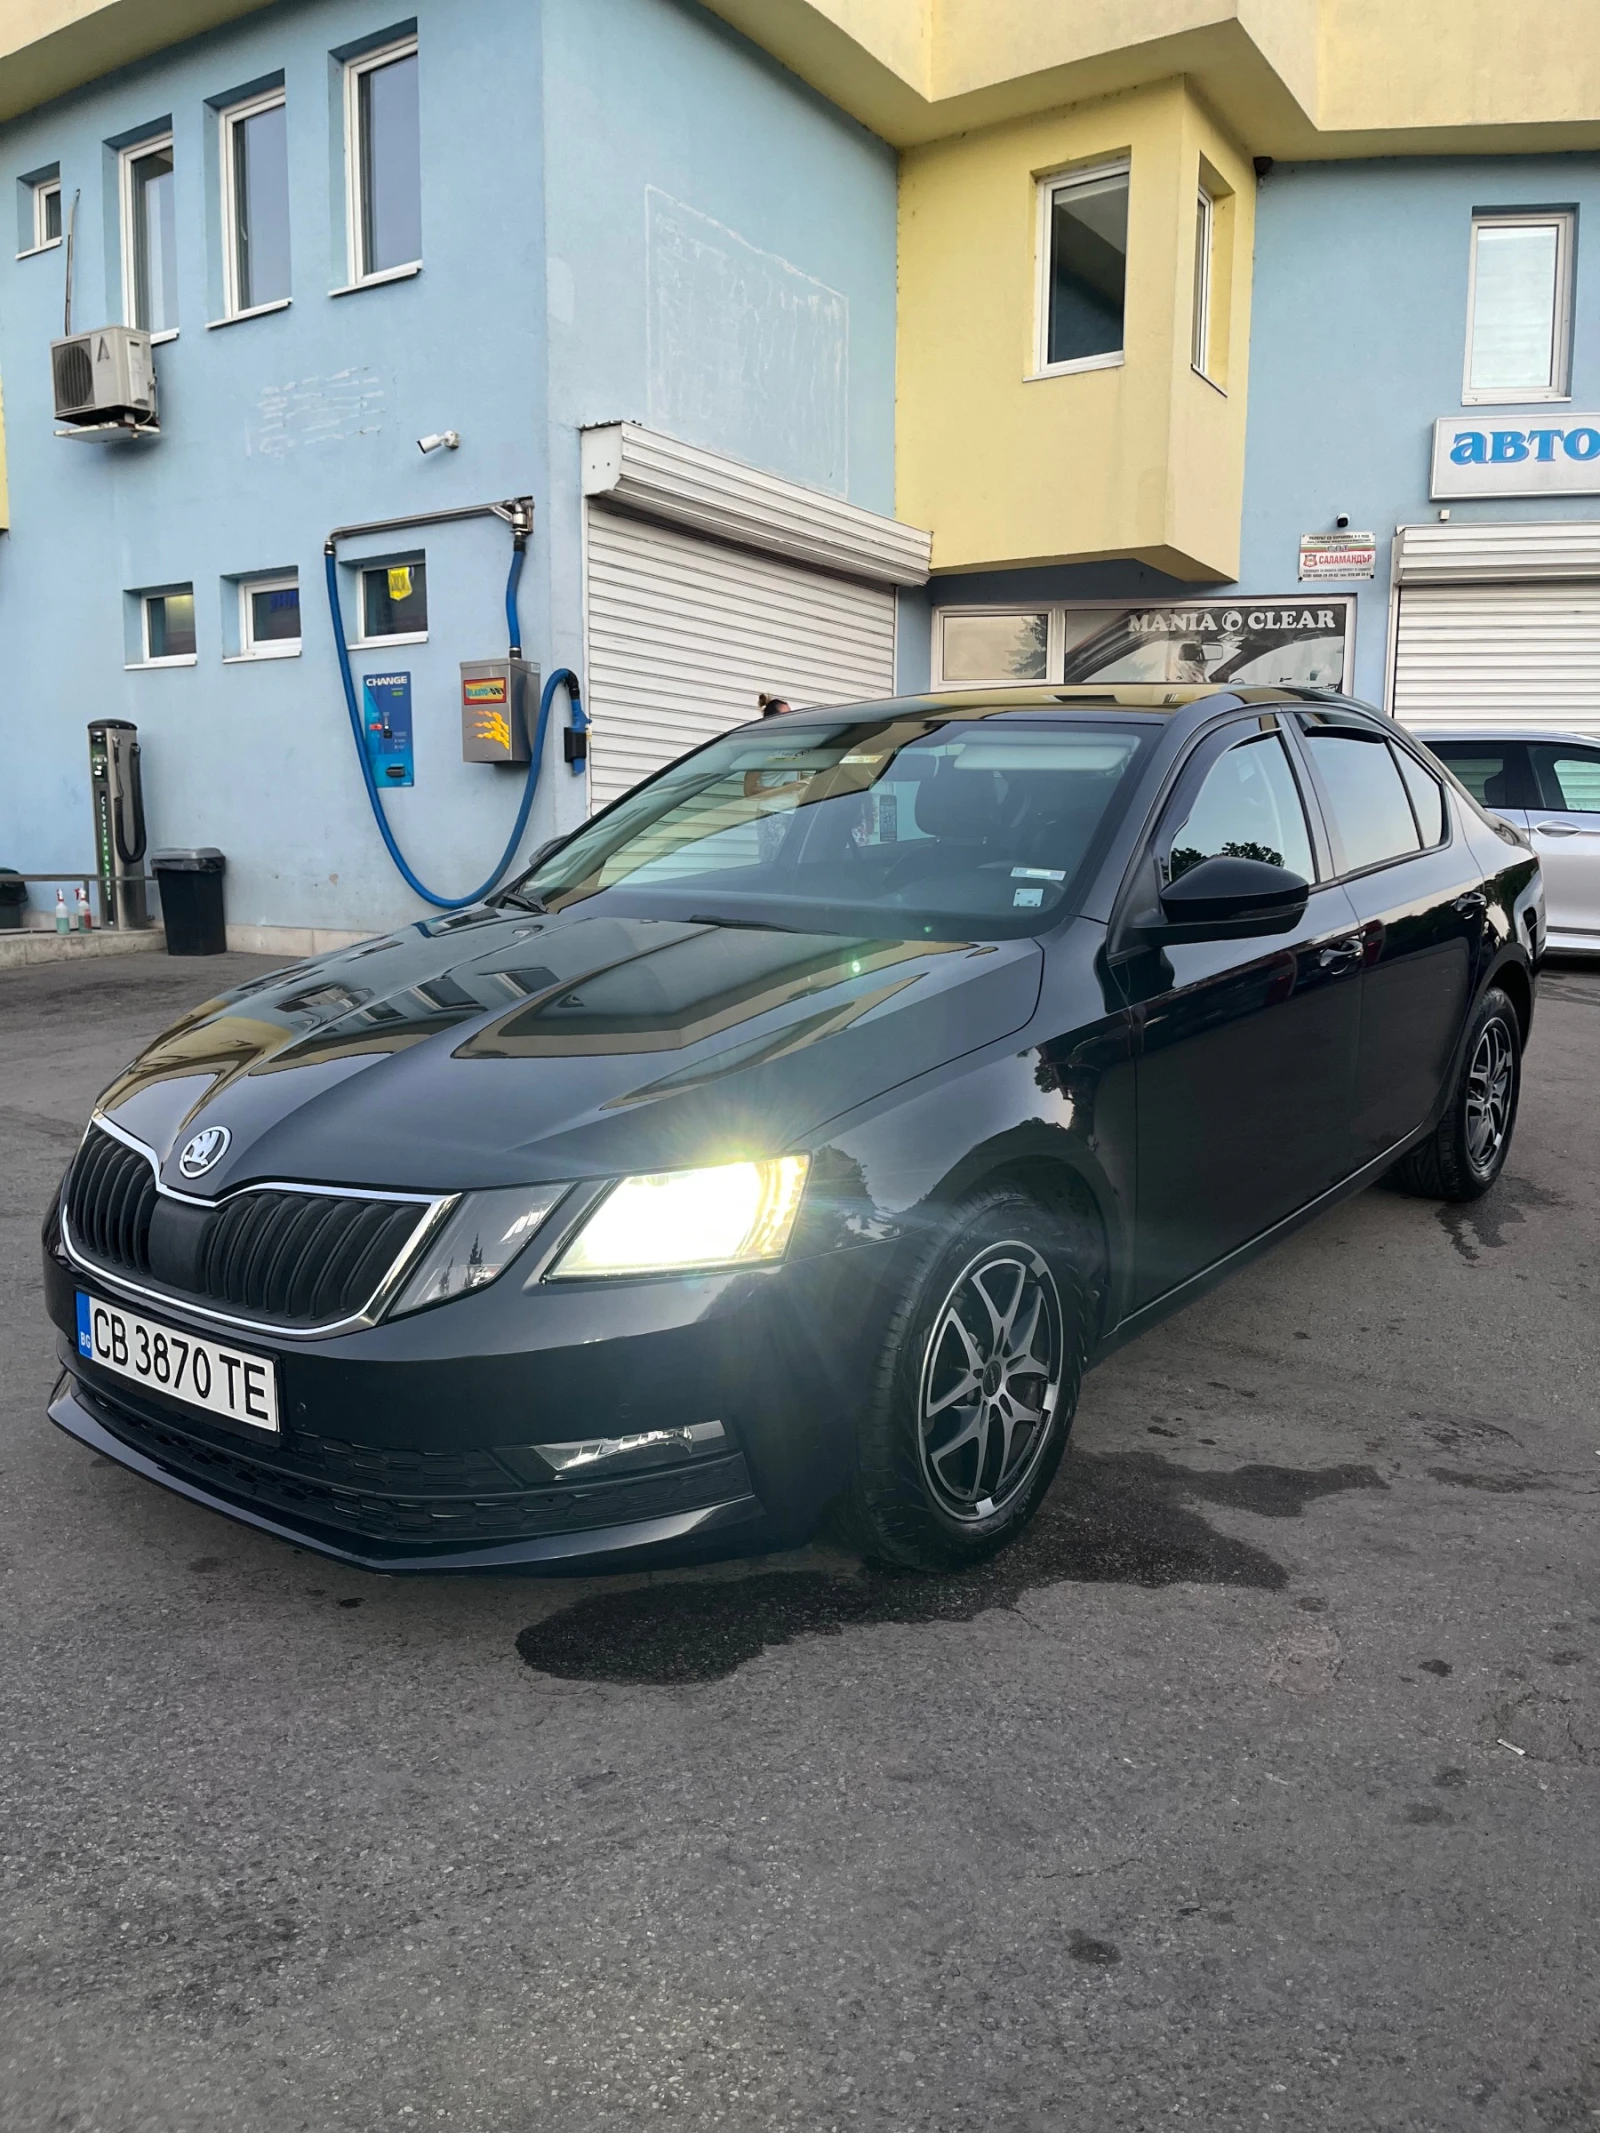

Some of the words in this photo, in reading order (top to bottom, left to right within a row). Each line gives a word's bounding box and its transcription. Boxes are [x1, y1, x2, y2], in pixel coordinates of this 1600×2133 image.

[1319, 554, 1373, 565] САЛАМАНДЪР
[1128, 613, 1218, 632] MANIA
[1248, 610, 1335, 629] CLEAR
[366, 676, 408, 687] CHANGE
[80, 1331, 91, 1348] BG
[94, 1308, 129, 1367] CB
[135, 1324, 212, 1399] 3870
[219, 1353, 268, 1421] TE
